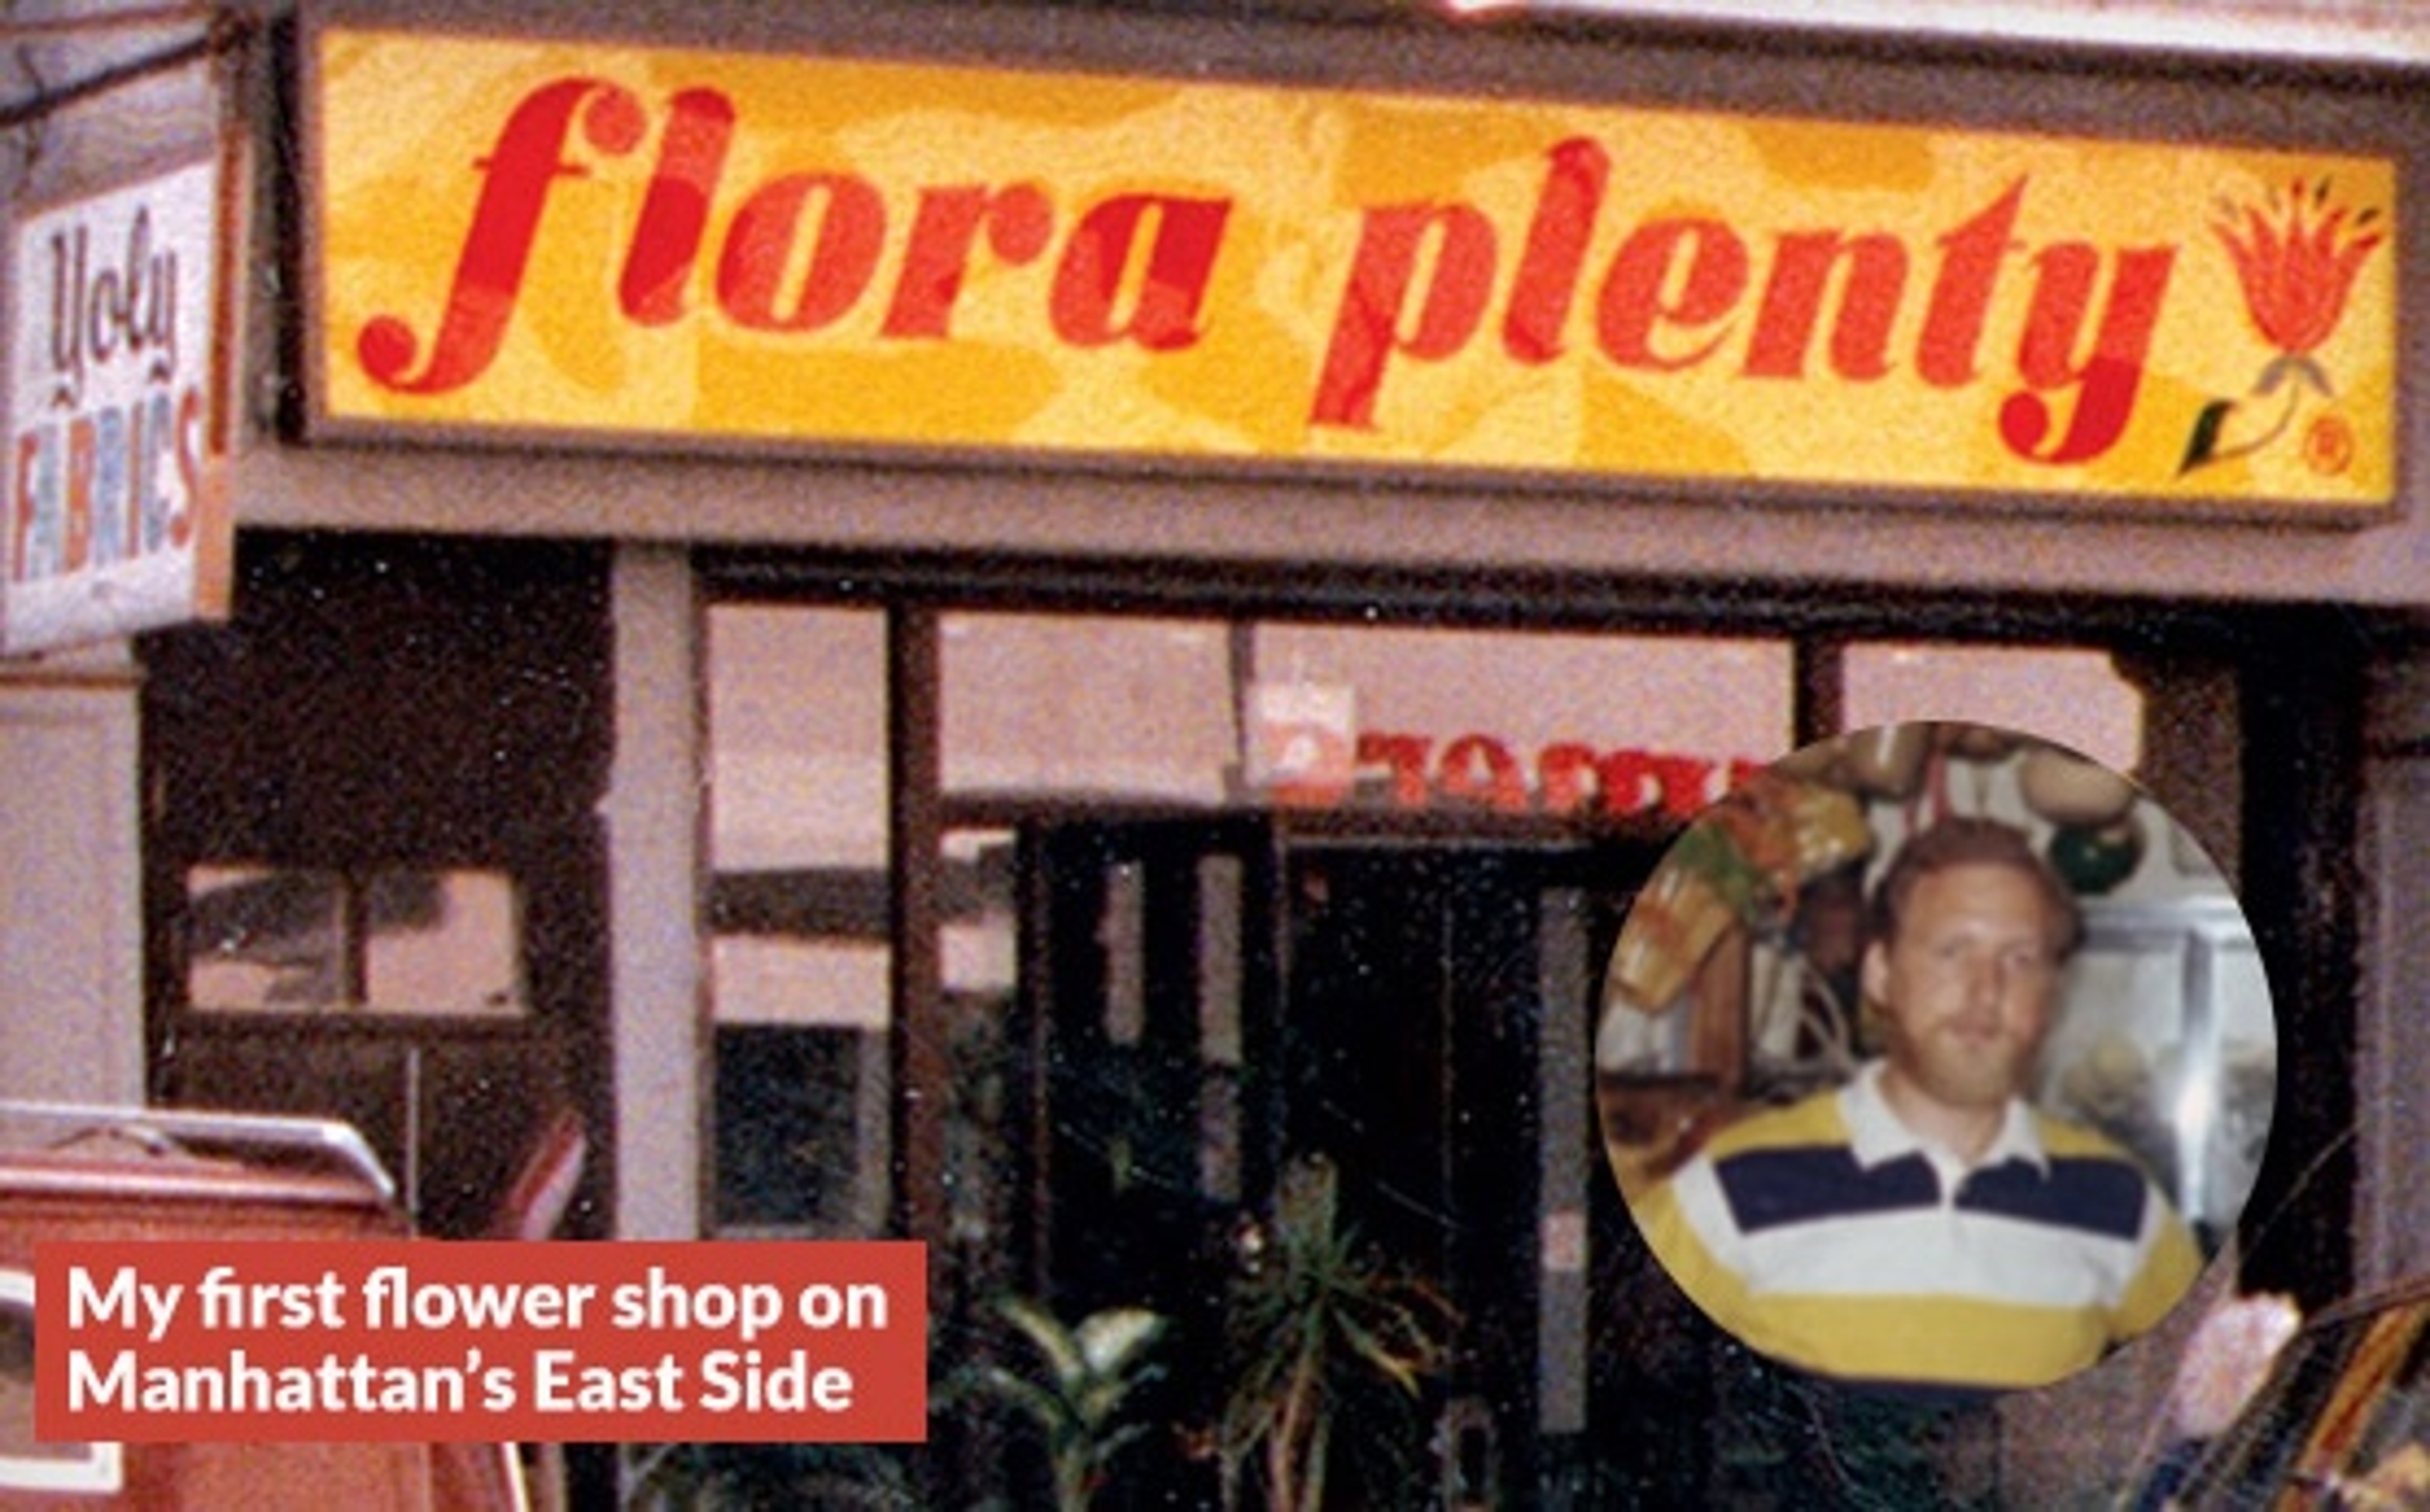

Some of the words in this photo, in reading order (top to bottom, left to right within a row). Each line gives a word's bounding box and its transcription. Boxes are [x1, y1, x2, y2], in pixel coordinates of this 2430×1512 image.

[51, 206, 179, 408] Yoly
[356, 76, 1235, 396] flora
[1305, 135, 2181, 466] plenty
[13, 386, 200, 583] FABRICS
